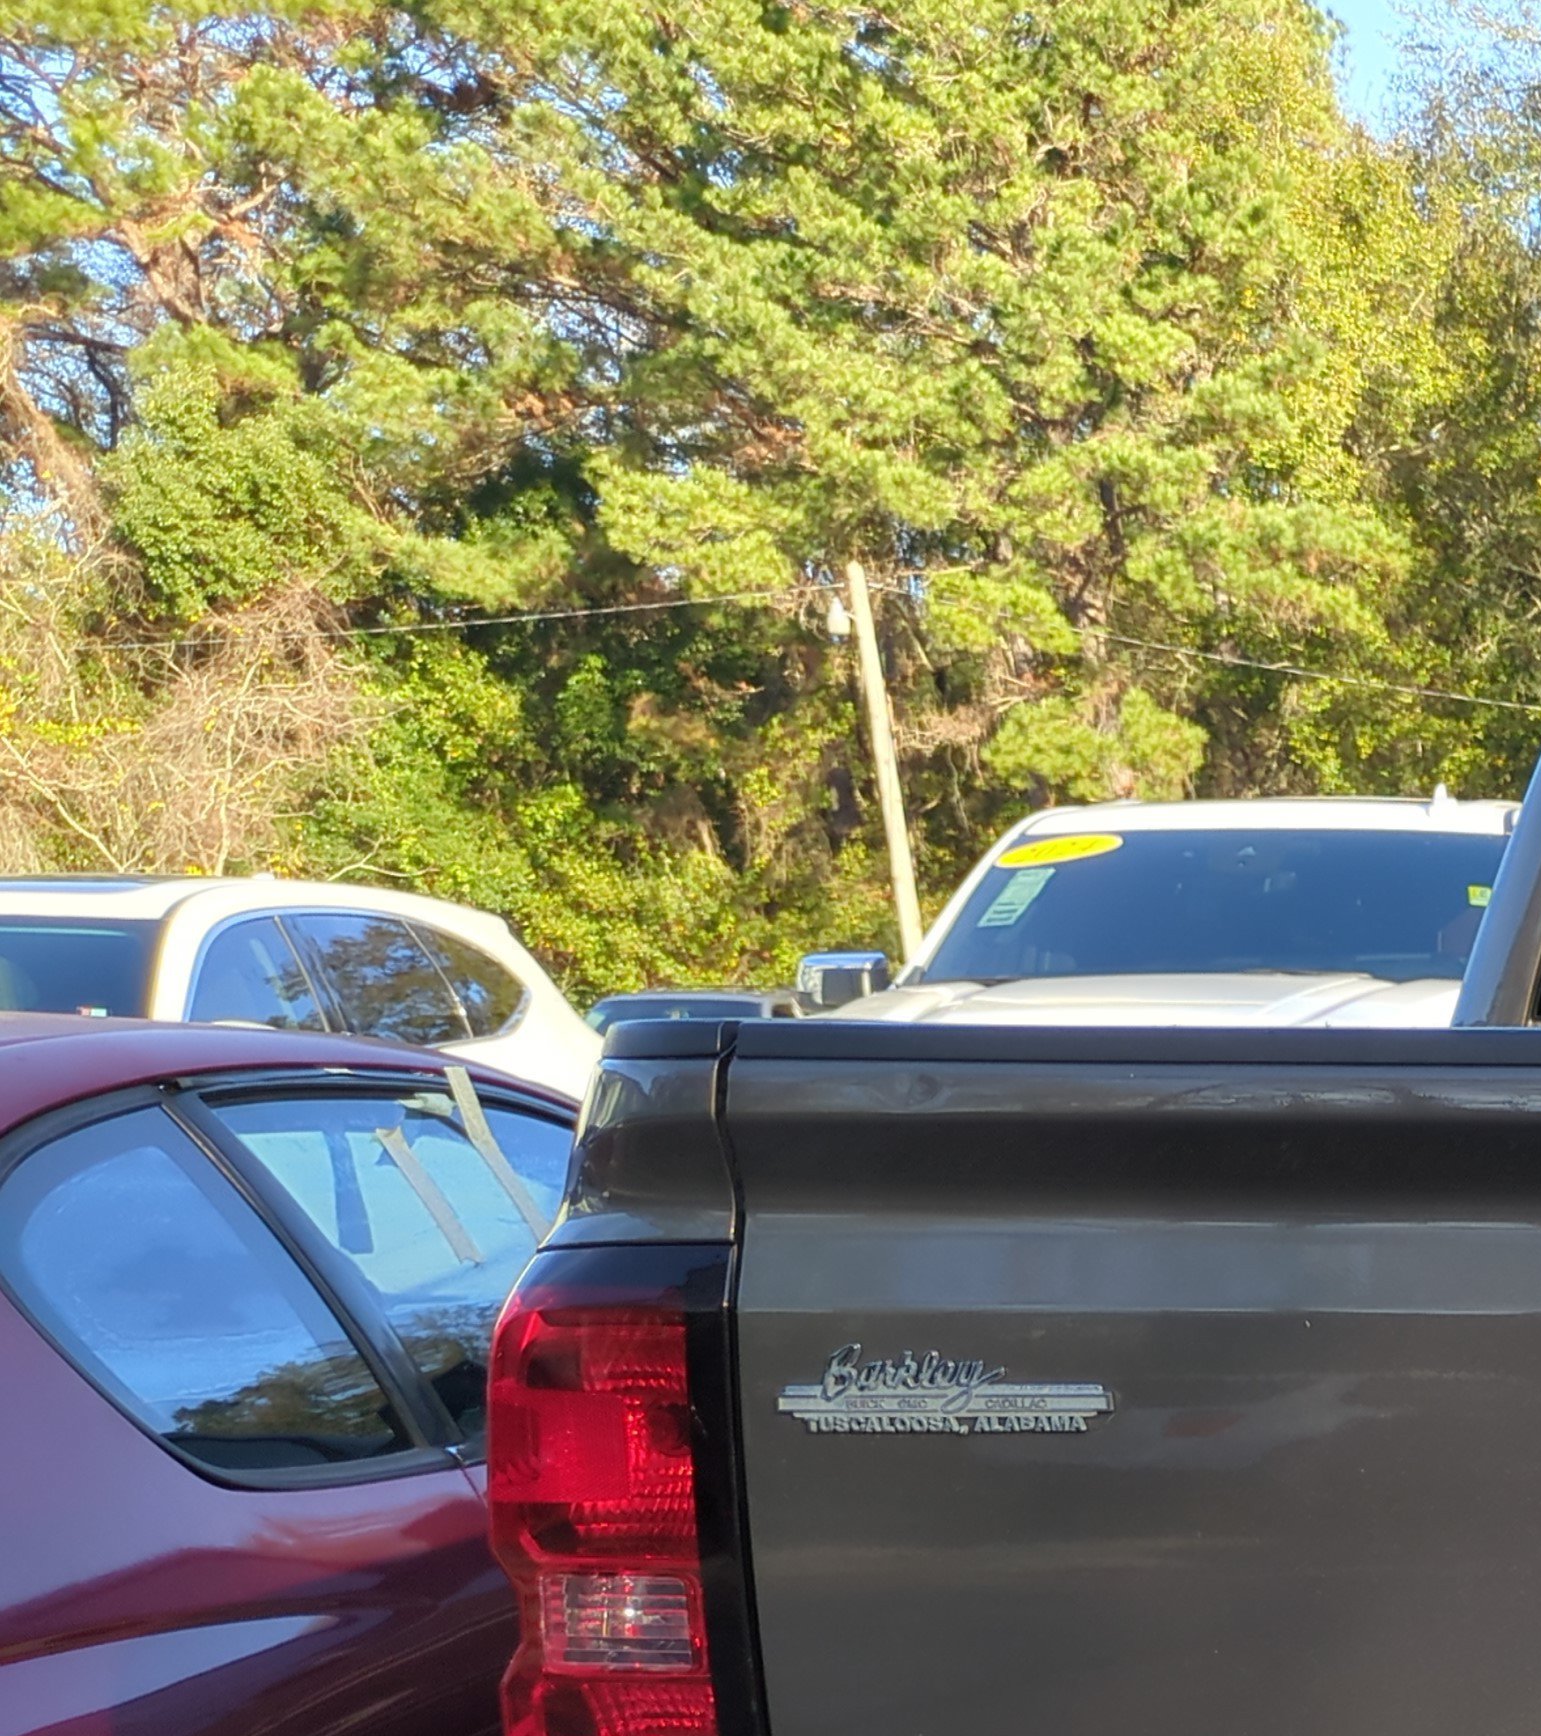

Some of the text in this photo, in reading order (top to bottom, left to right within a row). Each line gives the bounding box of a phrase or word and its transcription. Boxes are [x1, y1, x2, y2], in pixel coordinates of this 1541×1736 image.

[820, 1342, 1007, 1414] Barkley
[806, 1415, 1087, 1435] TUSCALOOSA, ALABAMA
